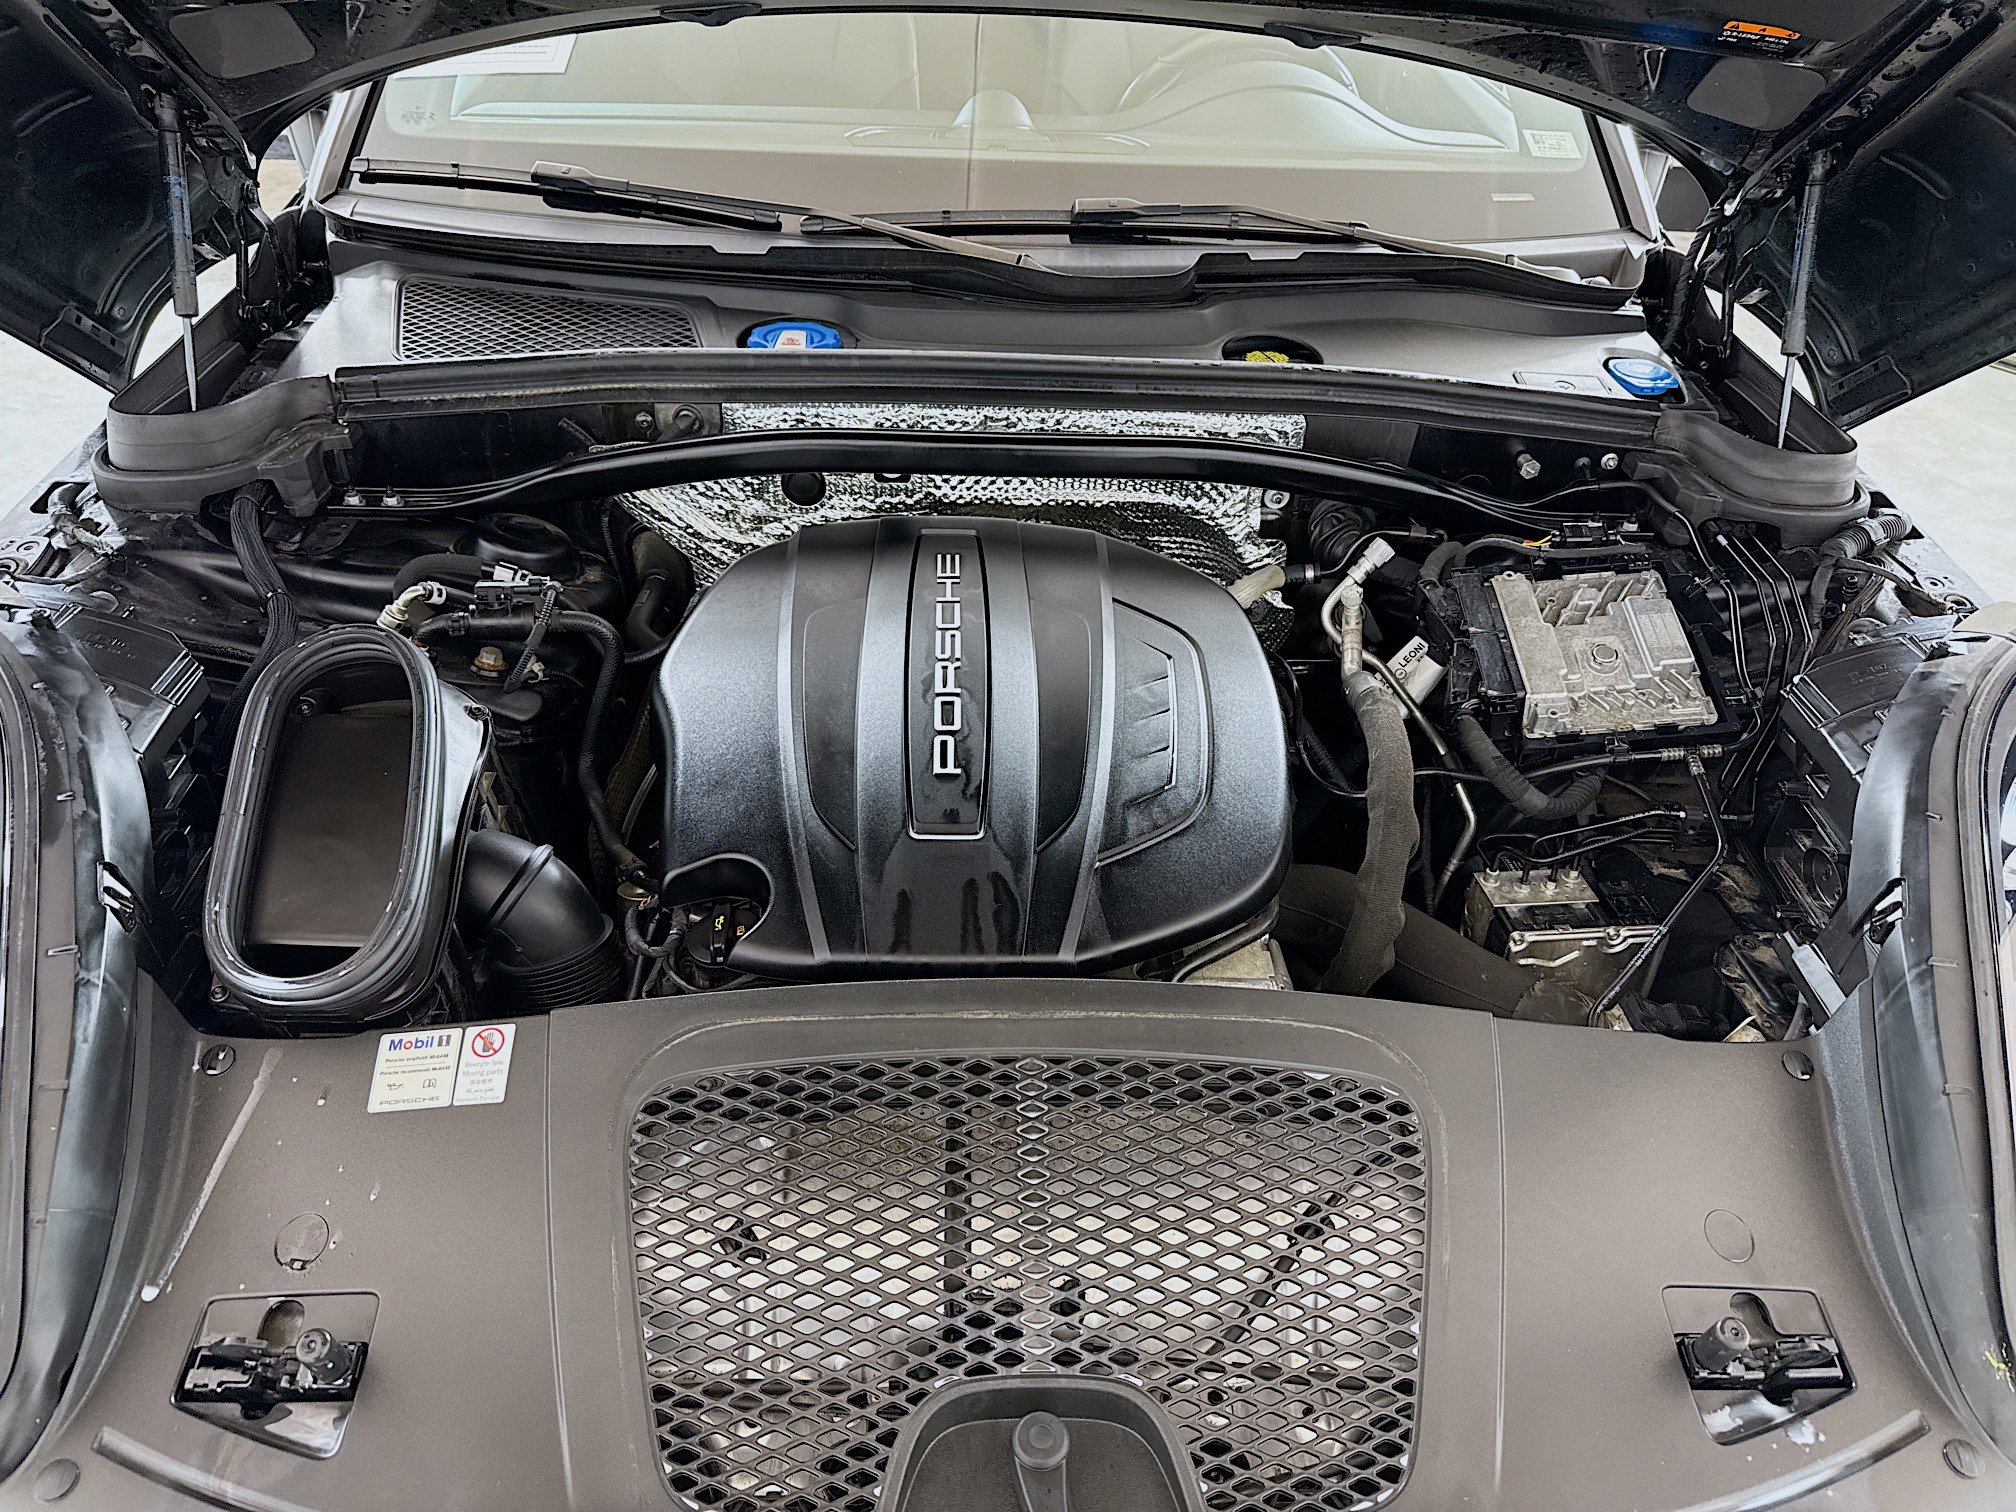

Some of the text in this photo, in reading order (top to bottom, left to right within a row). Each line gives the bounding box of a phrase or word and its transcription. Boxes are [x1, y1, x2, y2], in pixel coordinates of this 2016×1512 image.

[933, 553, 961, 776] PORSCHE
[1398, 642, 1426, 668] LEONI
[388, 1036, 434, 1051] Mobil
[379, 1096, 441, 1106] PORSCHE
